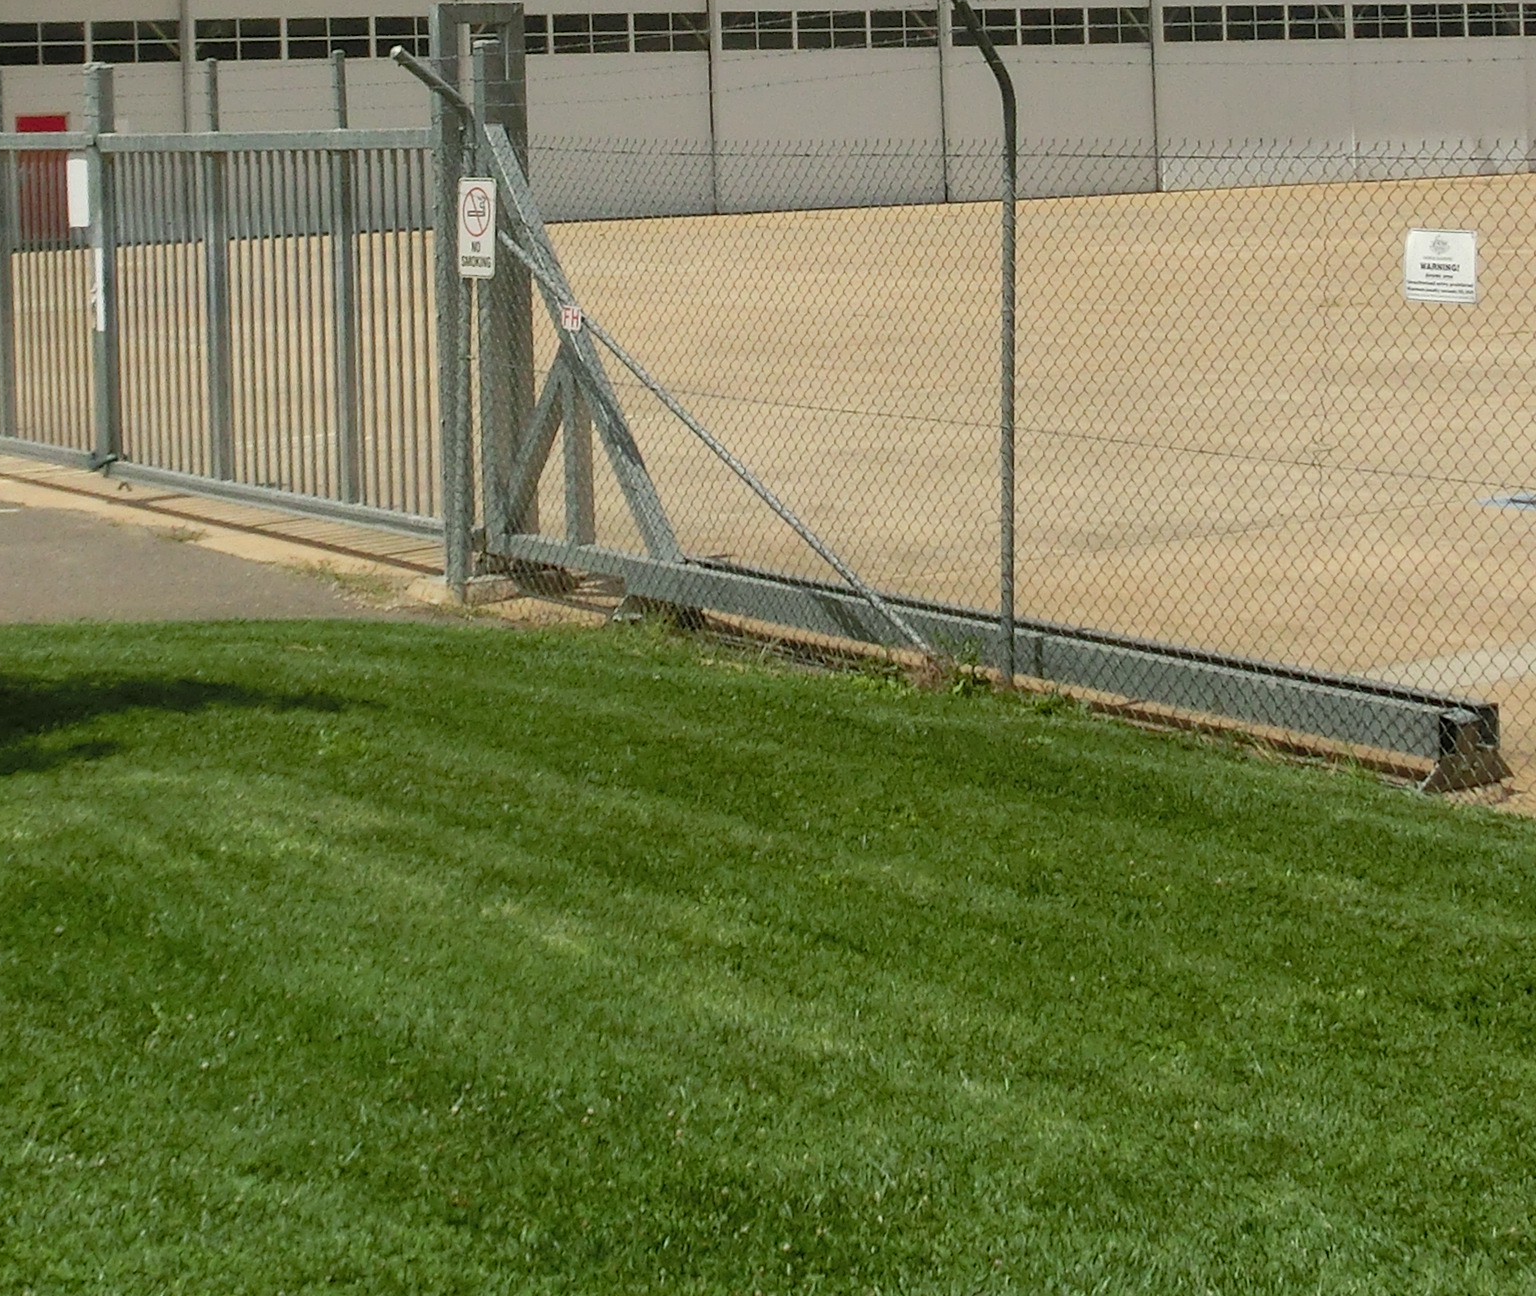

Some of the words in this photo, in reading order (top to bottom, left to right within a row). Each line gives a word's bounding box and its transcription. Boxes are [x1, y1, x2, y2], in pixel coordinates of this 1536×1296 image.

[471, 241, 481, 253] NO
[461, 256, 492, 268] SMOKING
[1420, 262, 1460, 272] WARNING!
